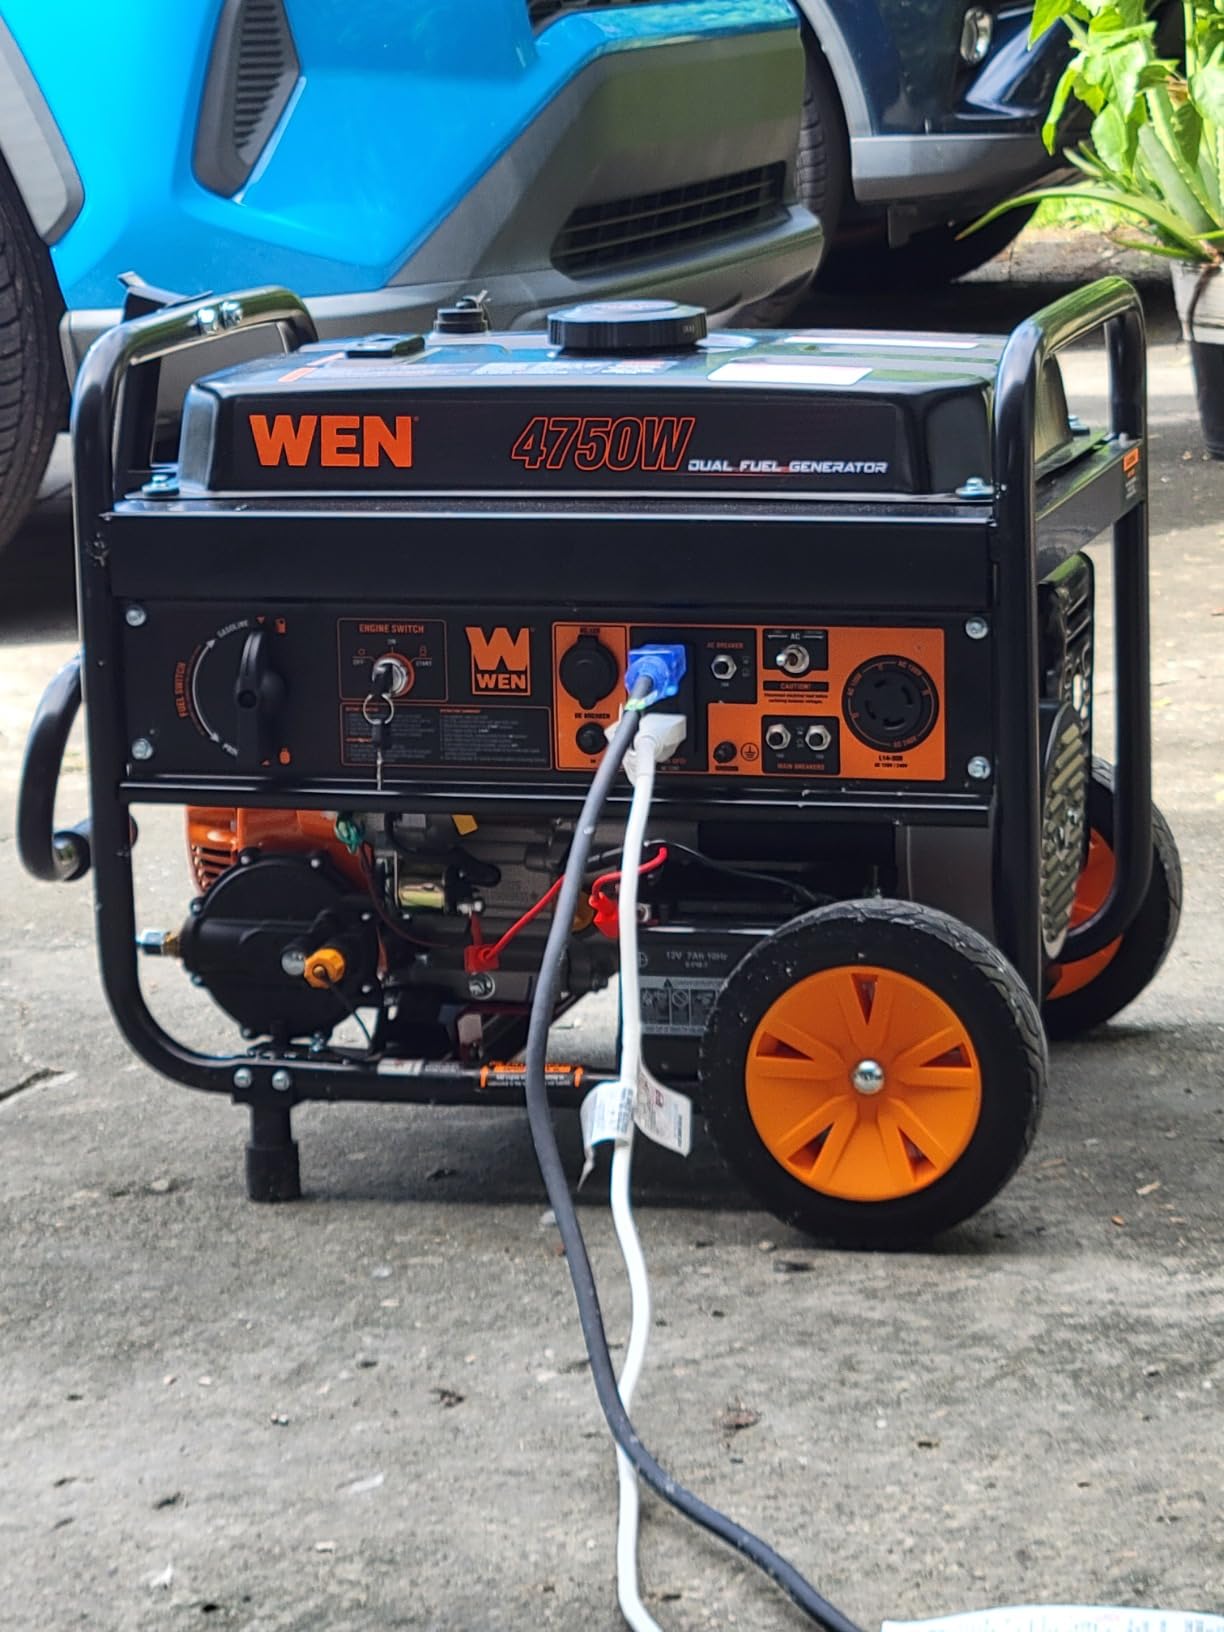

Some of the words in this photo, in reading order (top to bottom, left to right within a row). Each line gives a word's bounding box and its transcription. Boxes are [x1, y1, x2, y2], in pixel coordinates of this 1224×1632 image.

[250, 415, 412, 467] WEN
[512, 416, 696, 470] 4750W
[687, 460, 733, 472] DUAL
[739, 460, 783, 473] FUEL
[788, 461, 888, 474] GENERATOR
[359, 623, 390, 633] ENGINE
[391, 624, 425, 634] SWITCH
[476, 673, 526, 689] WEN
